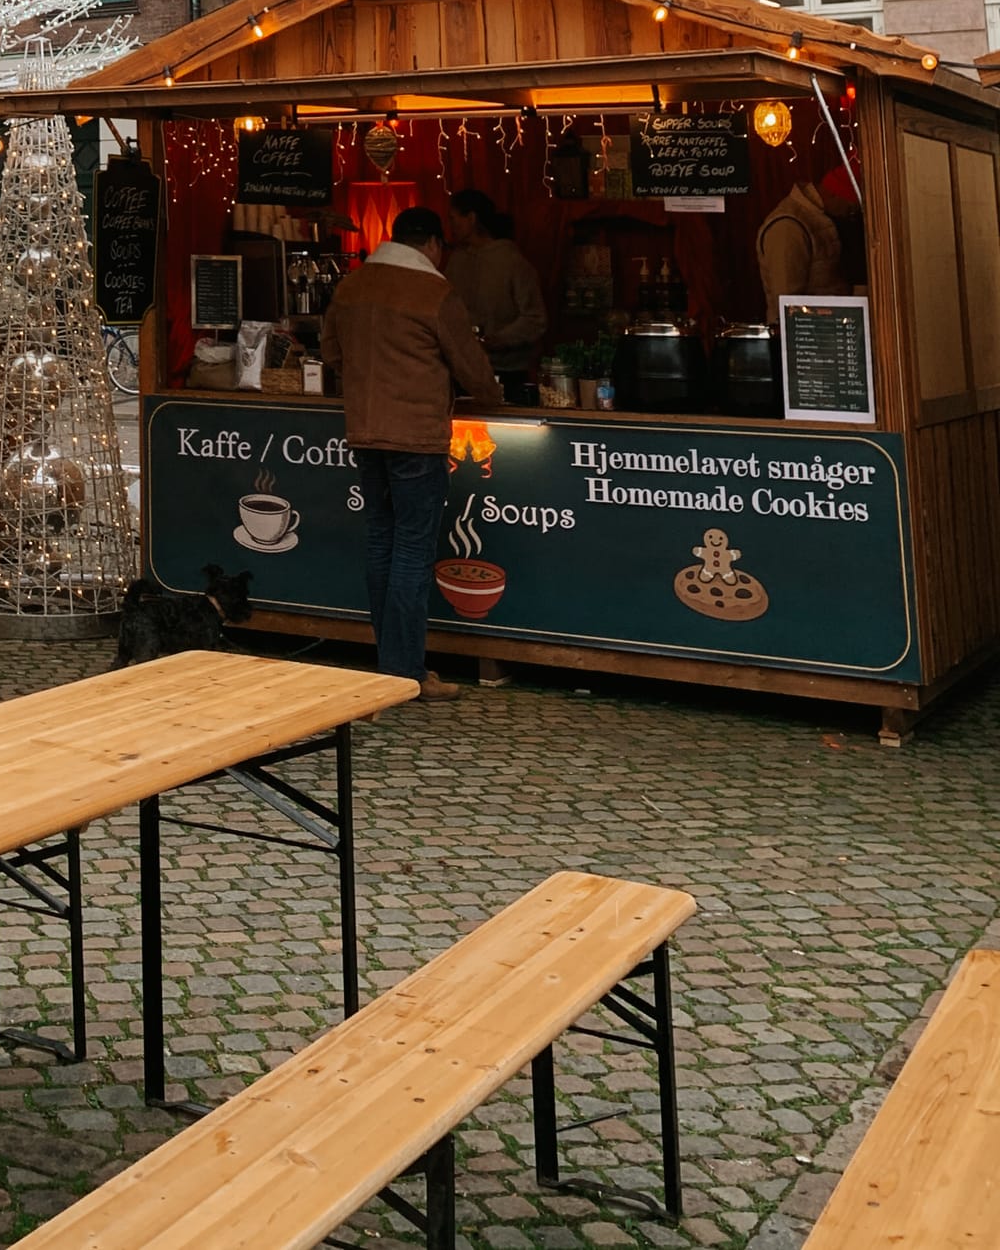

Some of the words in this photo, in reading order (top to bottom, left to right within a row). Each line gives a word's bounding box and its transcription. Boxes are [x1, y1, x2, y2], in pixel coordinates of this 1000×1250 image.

[262, 134, 301, 150] KAFFE
[252, 150, 303, 167] COFFEE
[104, 185, 149, 211] COFFEE
[110, 239, 142, 260] SOUPS
[104, 270, 146, 292] COOKIES
[114, 296, 134, 314] TEA
[177, 428, 252, 460] Kaffe
[570, 441, 760, 478] Hjemmelavet
[767, 455, 876, 490] småger
[584, 477, 744, 513] Homemade
[752, 488, 869, 522] Cookies
[481, 495, 576, 534] Soups
